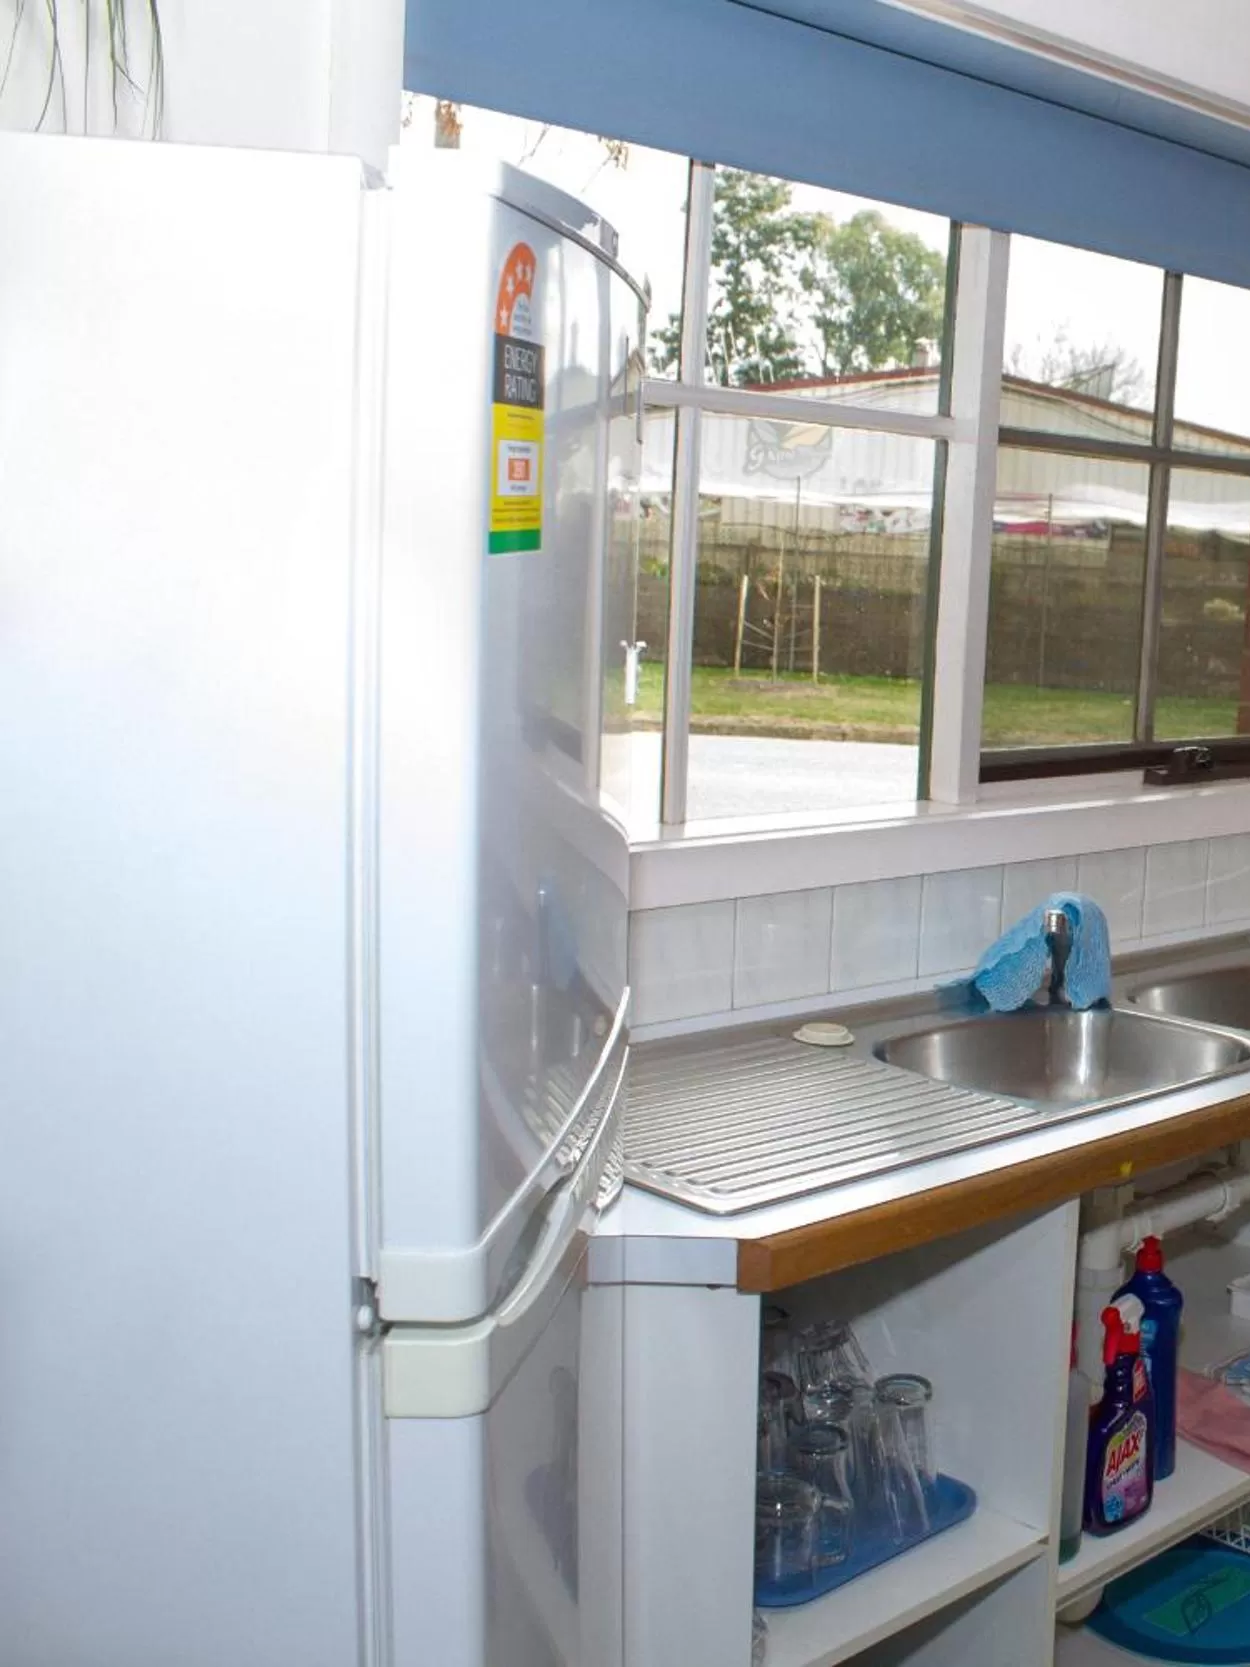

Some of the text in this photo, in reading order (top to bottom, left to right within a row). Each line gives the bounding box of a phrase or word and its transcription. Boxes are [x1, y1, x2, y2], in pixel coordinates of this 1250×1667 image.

[504, 344, 538, 374] ENERGY
[504, 373, 538, 403] RATING
[1106, 1430, 1140, 1477] AJAX
